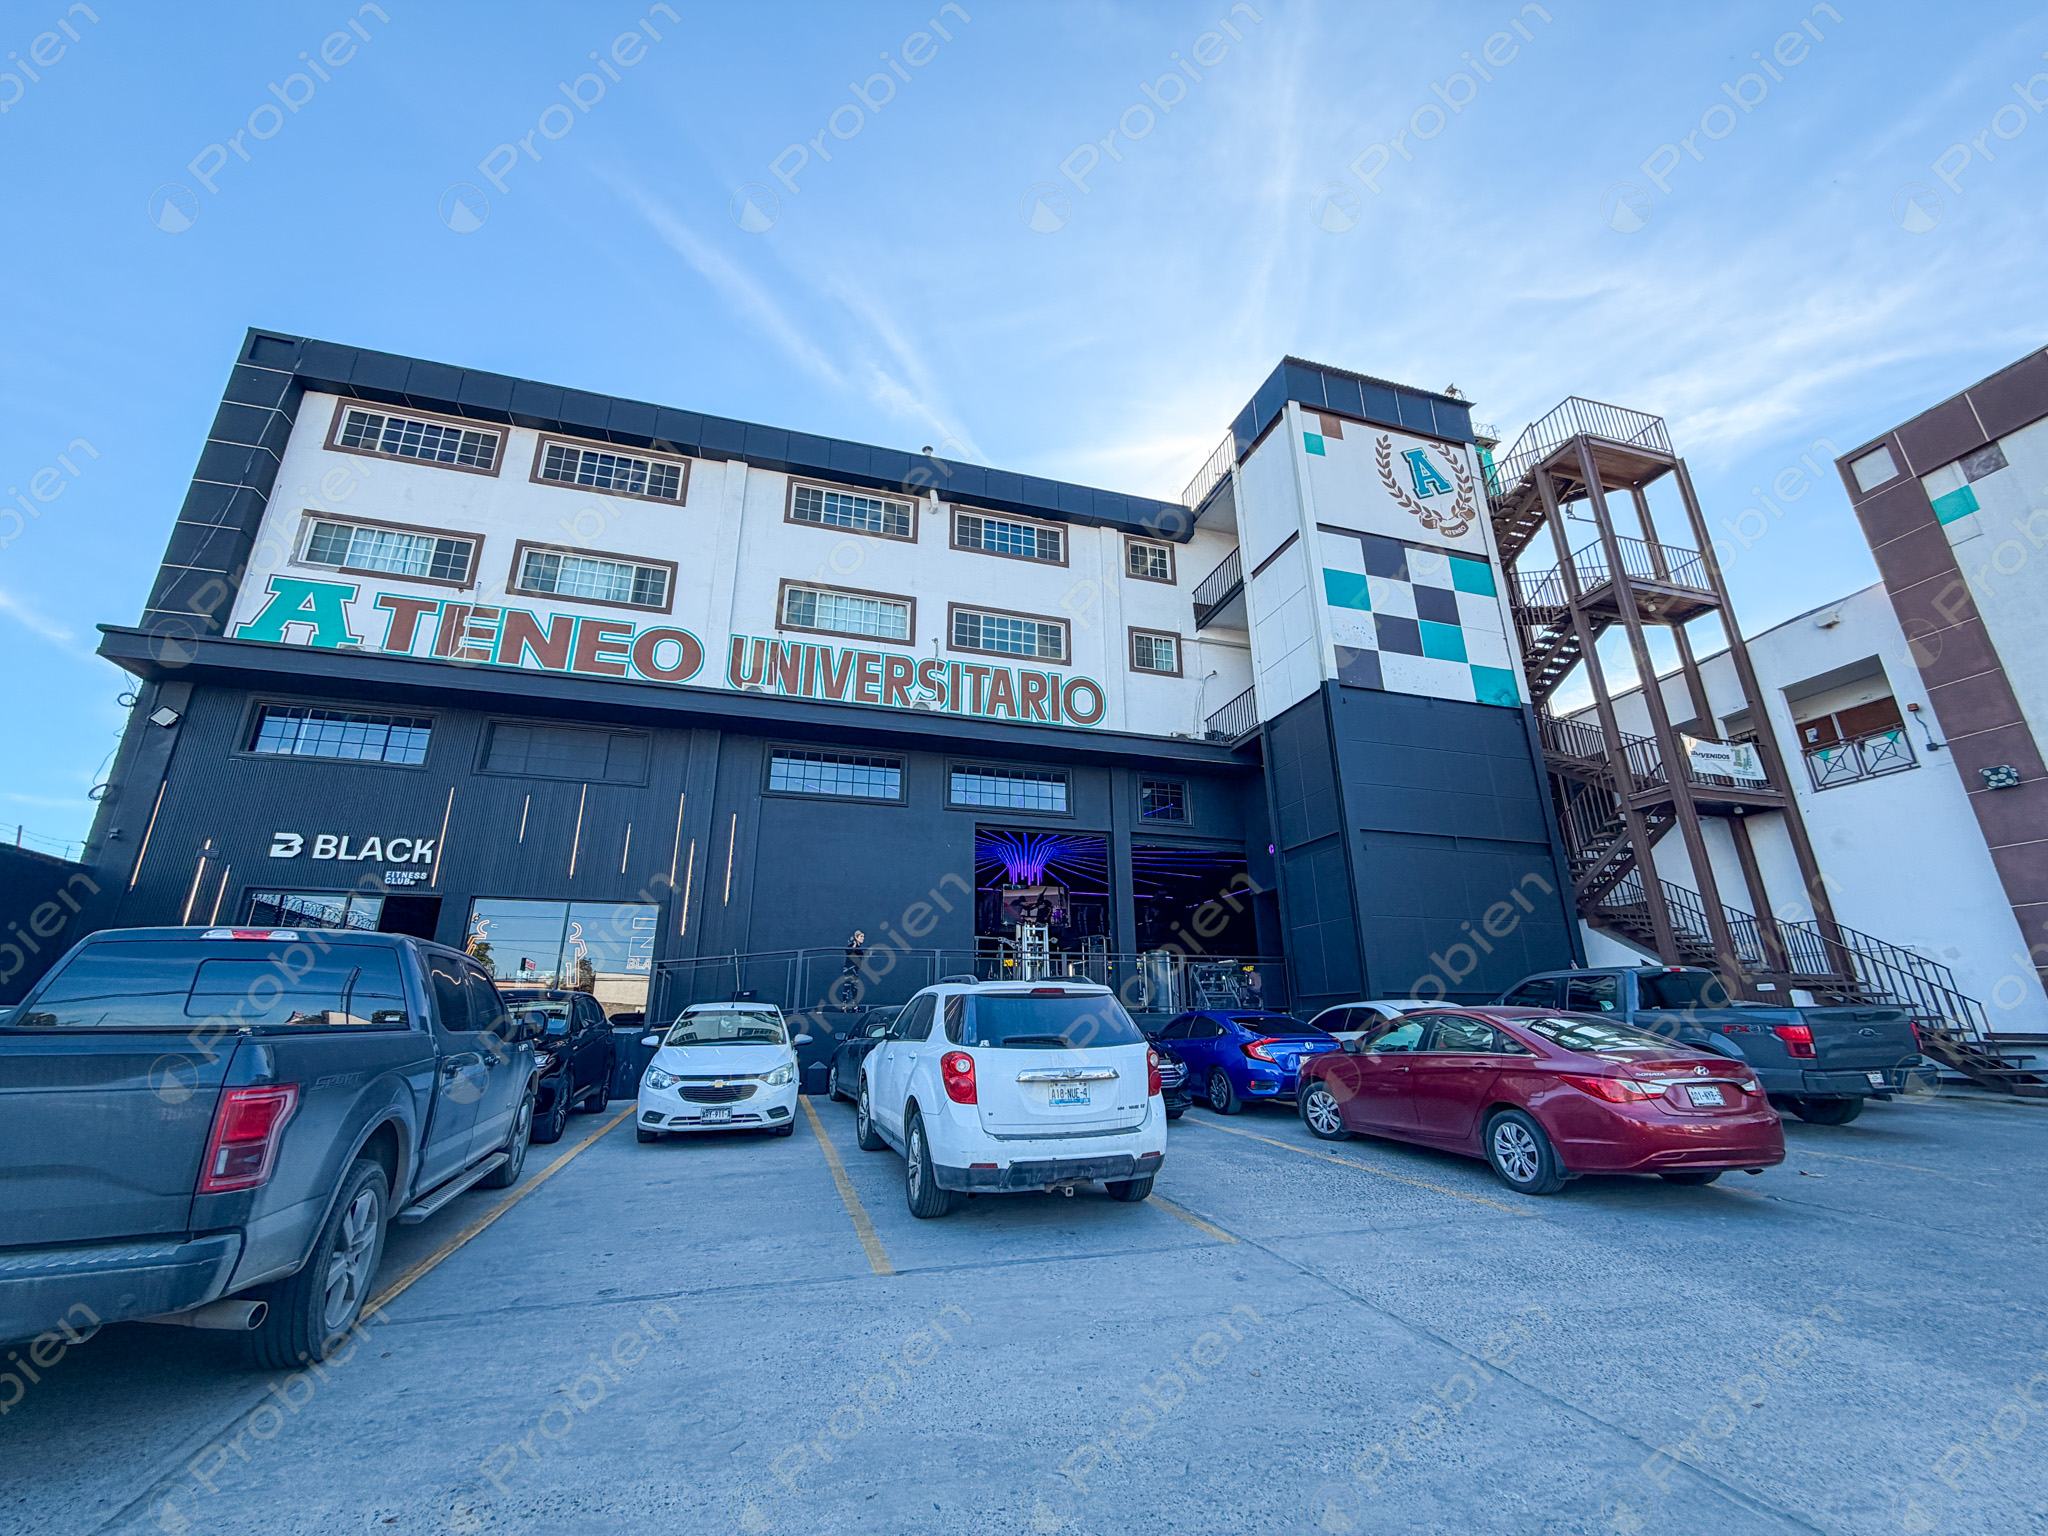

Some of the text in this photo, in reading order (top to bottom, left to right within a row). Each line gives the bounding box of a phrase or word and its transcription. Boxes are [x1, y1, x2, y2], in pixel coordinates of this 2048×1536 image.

[1401, 447, 1454, 499] A
[231, 574, 1106, 727] ATENEO UNIVERSITARIO
[312, 834, 436, 864] BLACK
[385, 870, 428, 880] FITNESS
